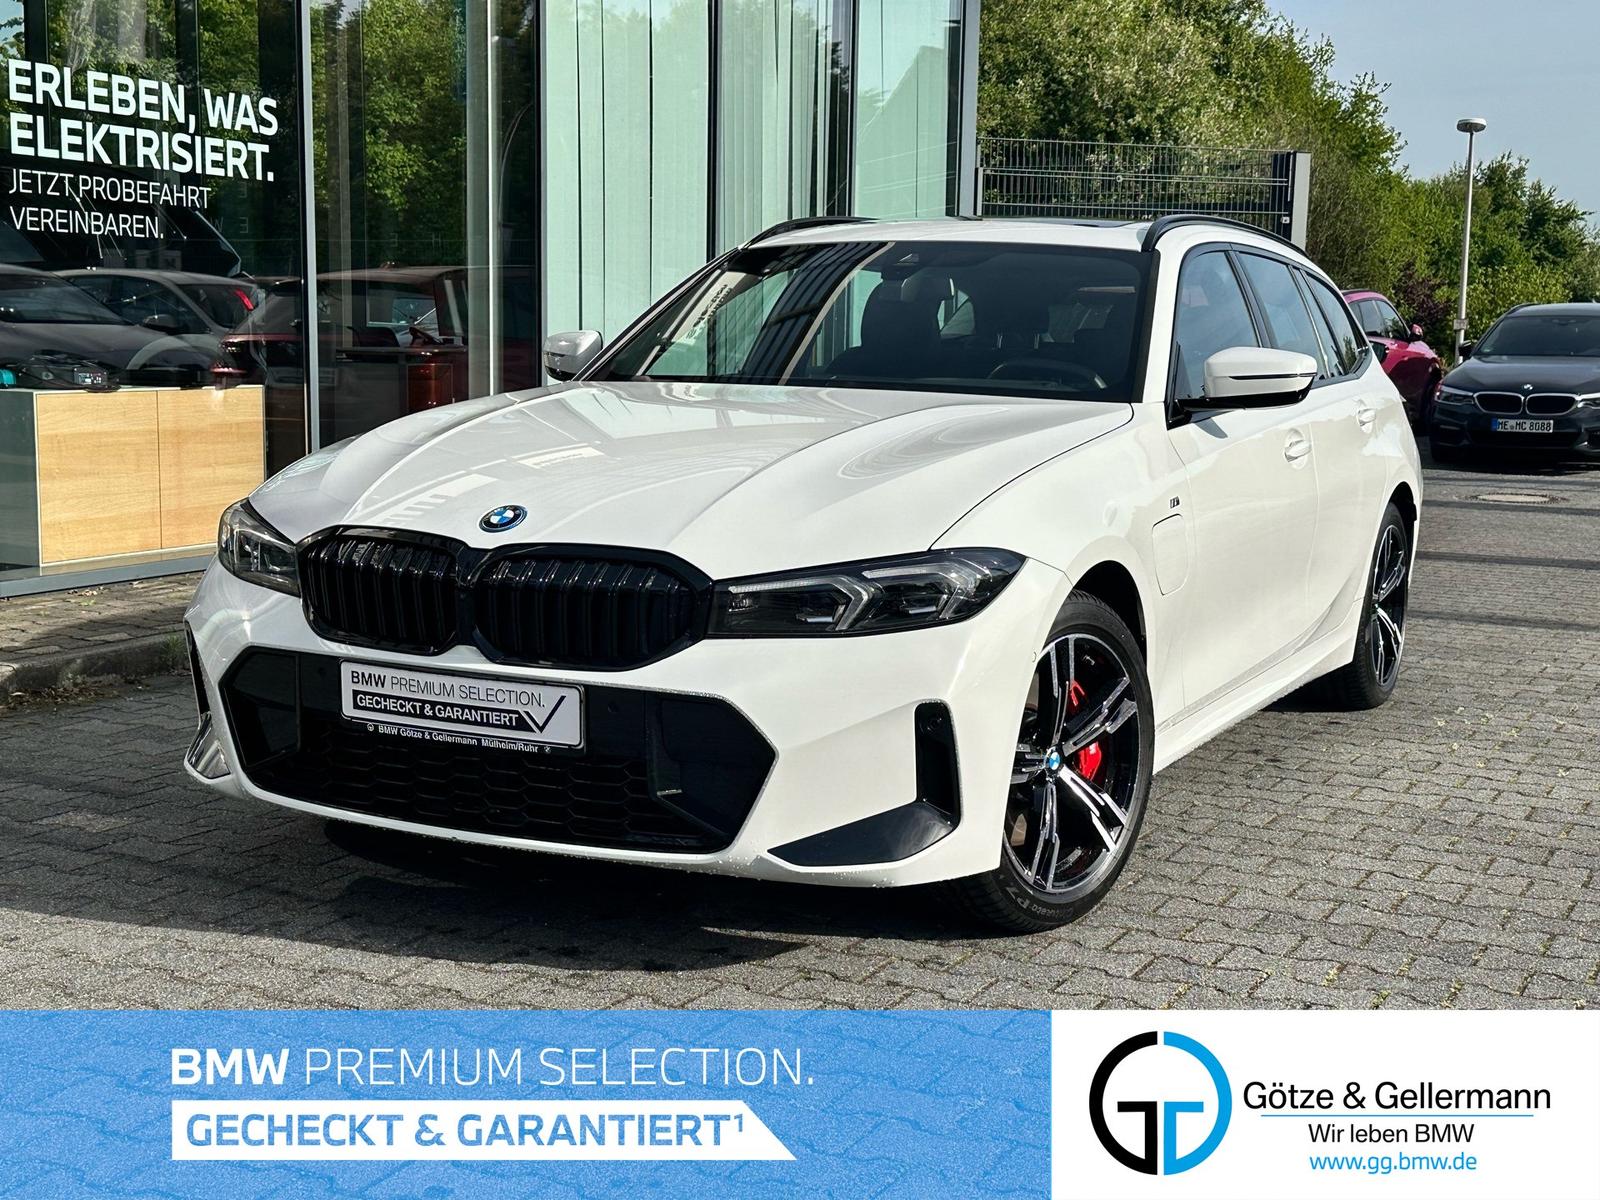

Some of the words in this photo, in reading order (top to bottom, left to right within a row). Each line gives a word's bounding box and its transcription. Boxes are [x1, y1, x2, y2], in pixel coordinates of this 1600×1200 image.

[8, 58, 196, 134] ERLEBEN,
[203, 88, 279, 136] WAS
[9, 112, 274, 182] ELEKTRISIERT.
[9, 168, 75, 197] JETZT
[78, 174, 212, 210] PROBEFAHRT
[9, 205, 164, 240] VEREINBAREN.
[1497, 420, 1509, 430] ME
[1515, 421, 1527, 431] MC
[1529, 421, 1551, 432] 8088
[351, 670, 386, 688] BMW
[391, 676, 455, 696] PREMIUM
[459, 684, 546, 708] SELECTION.
[356, 694, 422, 715] GECHECKT
[423, 703, 434, 716] &
[435, 704, 519, 726] GARANTIERT
[378, 724, 398, 736] BMW
[400, 727, 423, 739] Götze
[424, 731, 431, 740] &
[432, 731, 478, 747] Gellermann
[481, 737, 539, 754] Mülheim/Ruhr
